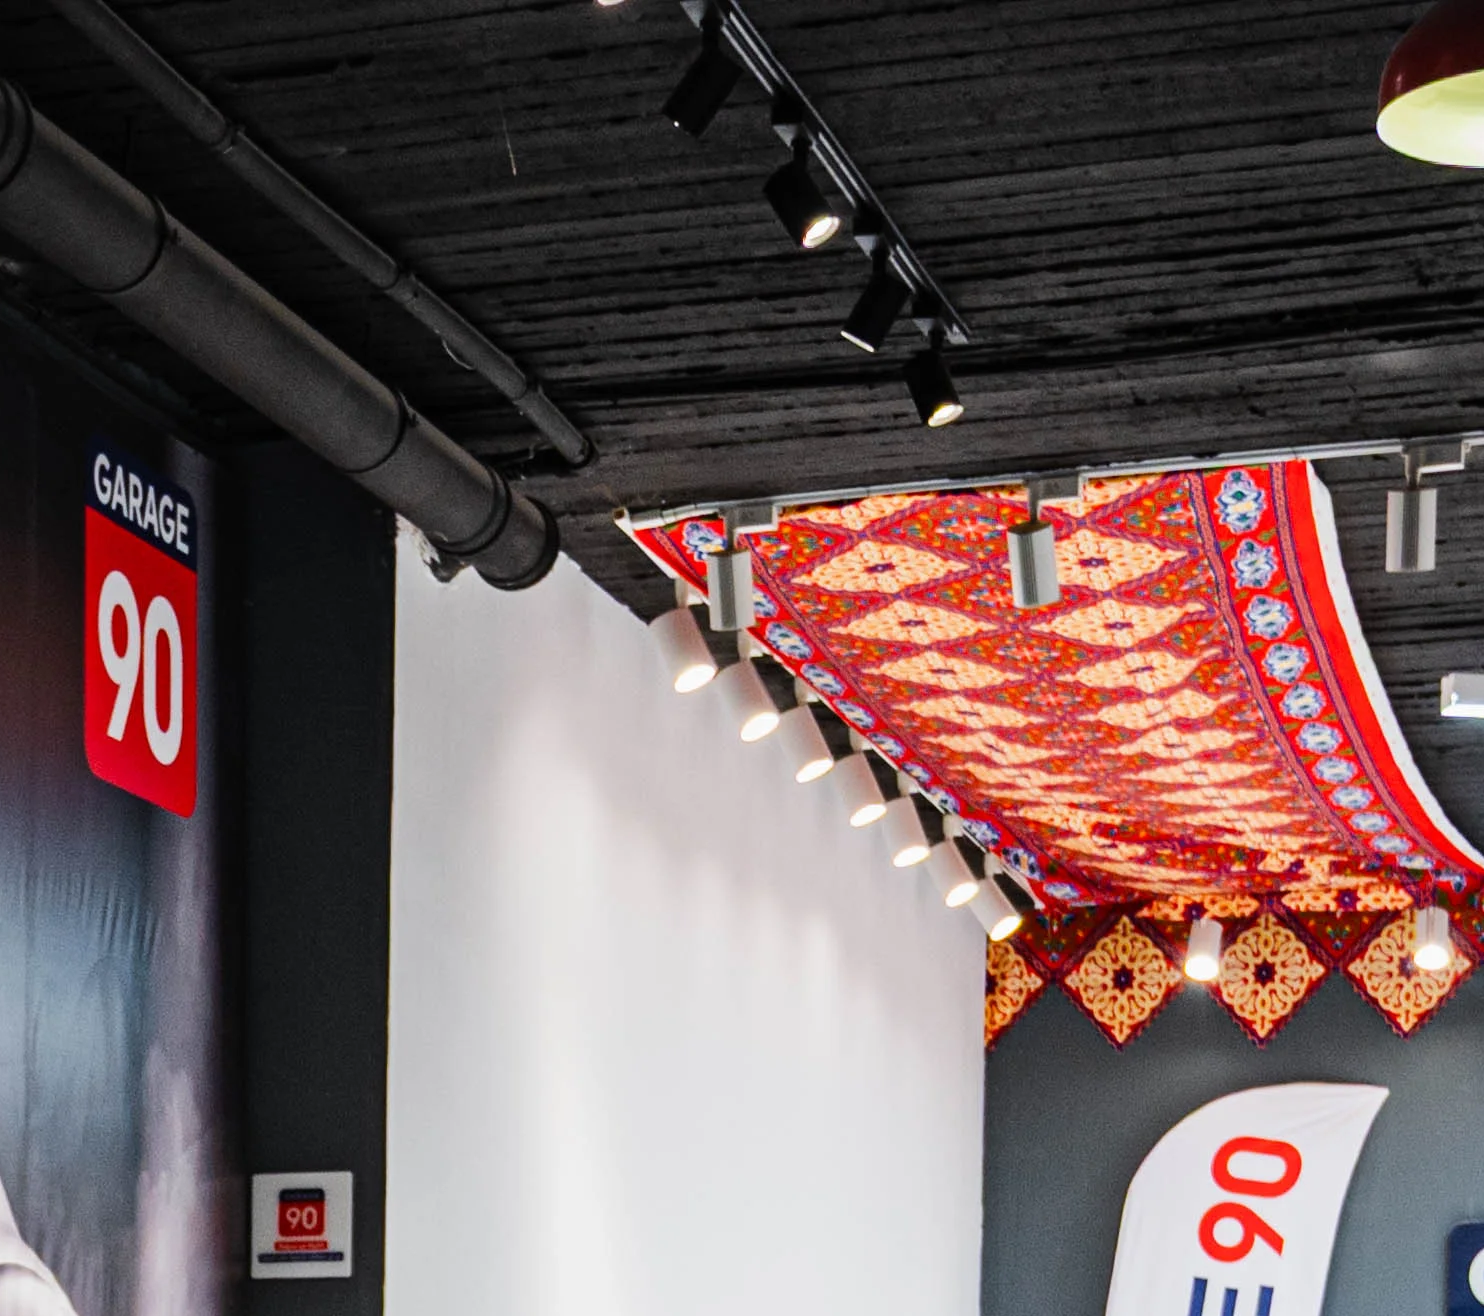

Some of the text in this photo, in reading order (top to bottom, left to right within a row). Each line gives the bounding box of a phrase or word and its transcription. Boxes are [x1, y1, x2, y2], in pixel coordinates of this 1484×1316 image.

[93, 452, 191, 556] GARAGE
[98, 570, 184, 766] 90
[285, 1206, 318, 1230] 90
